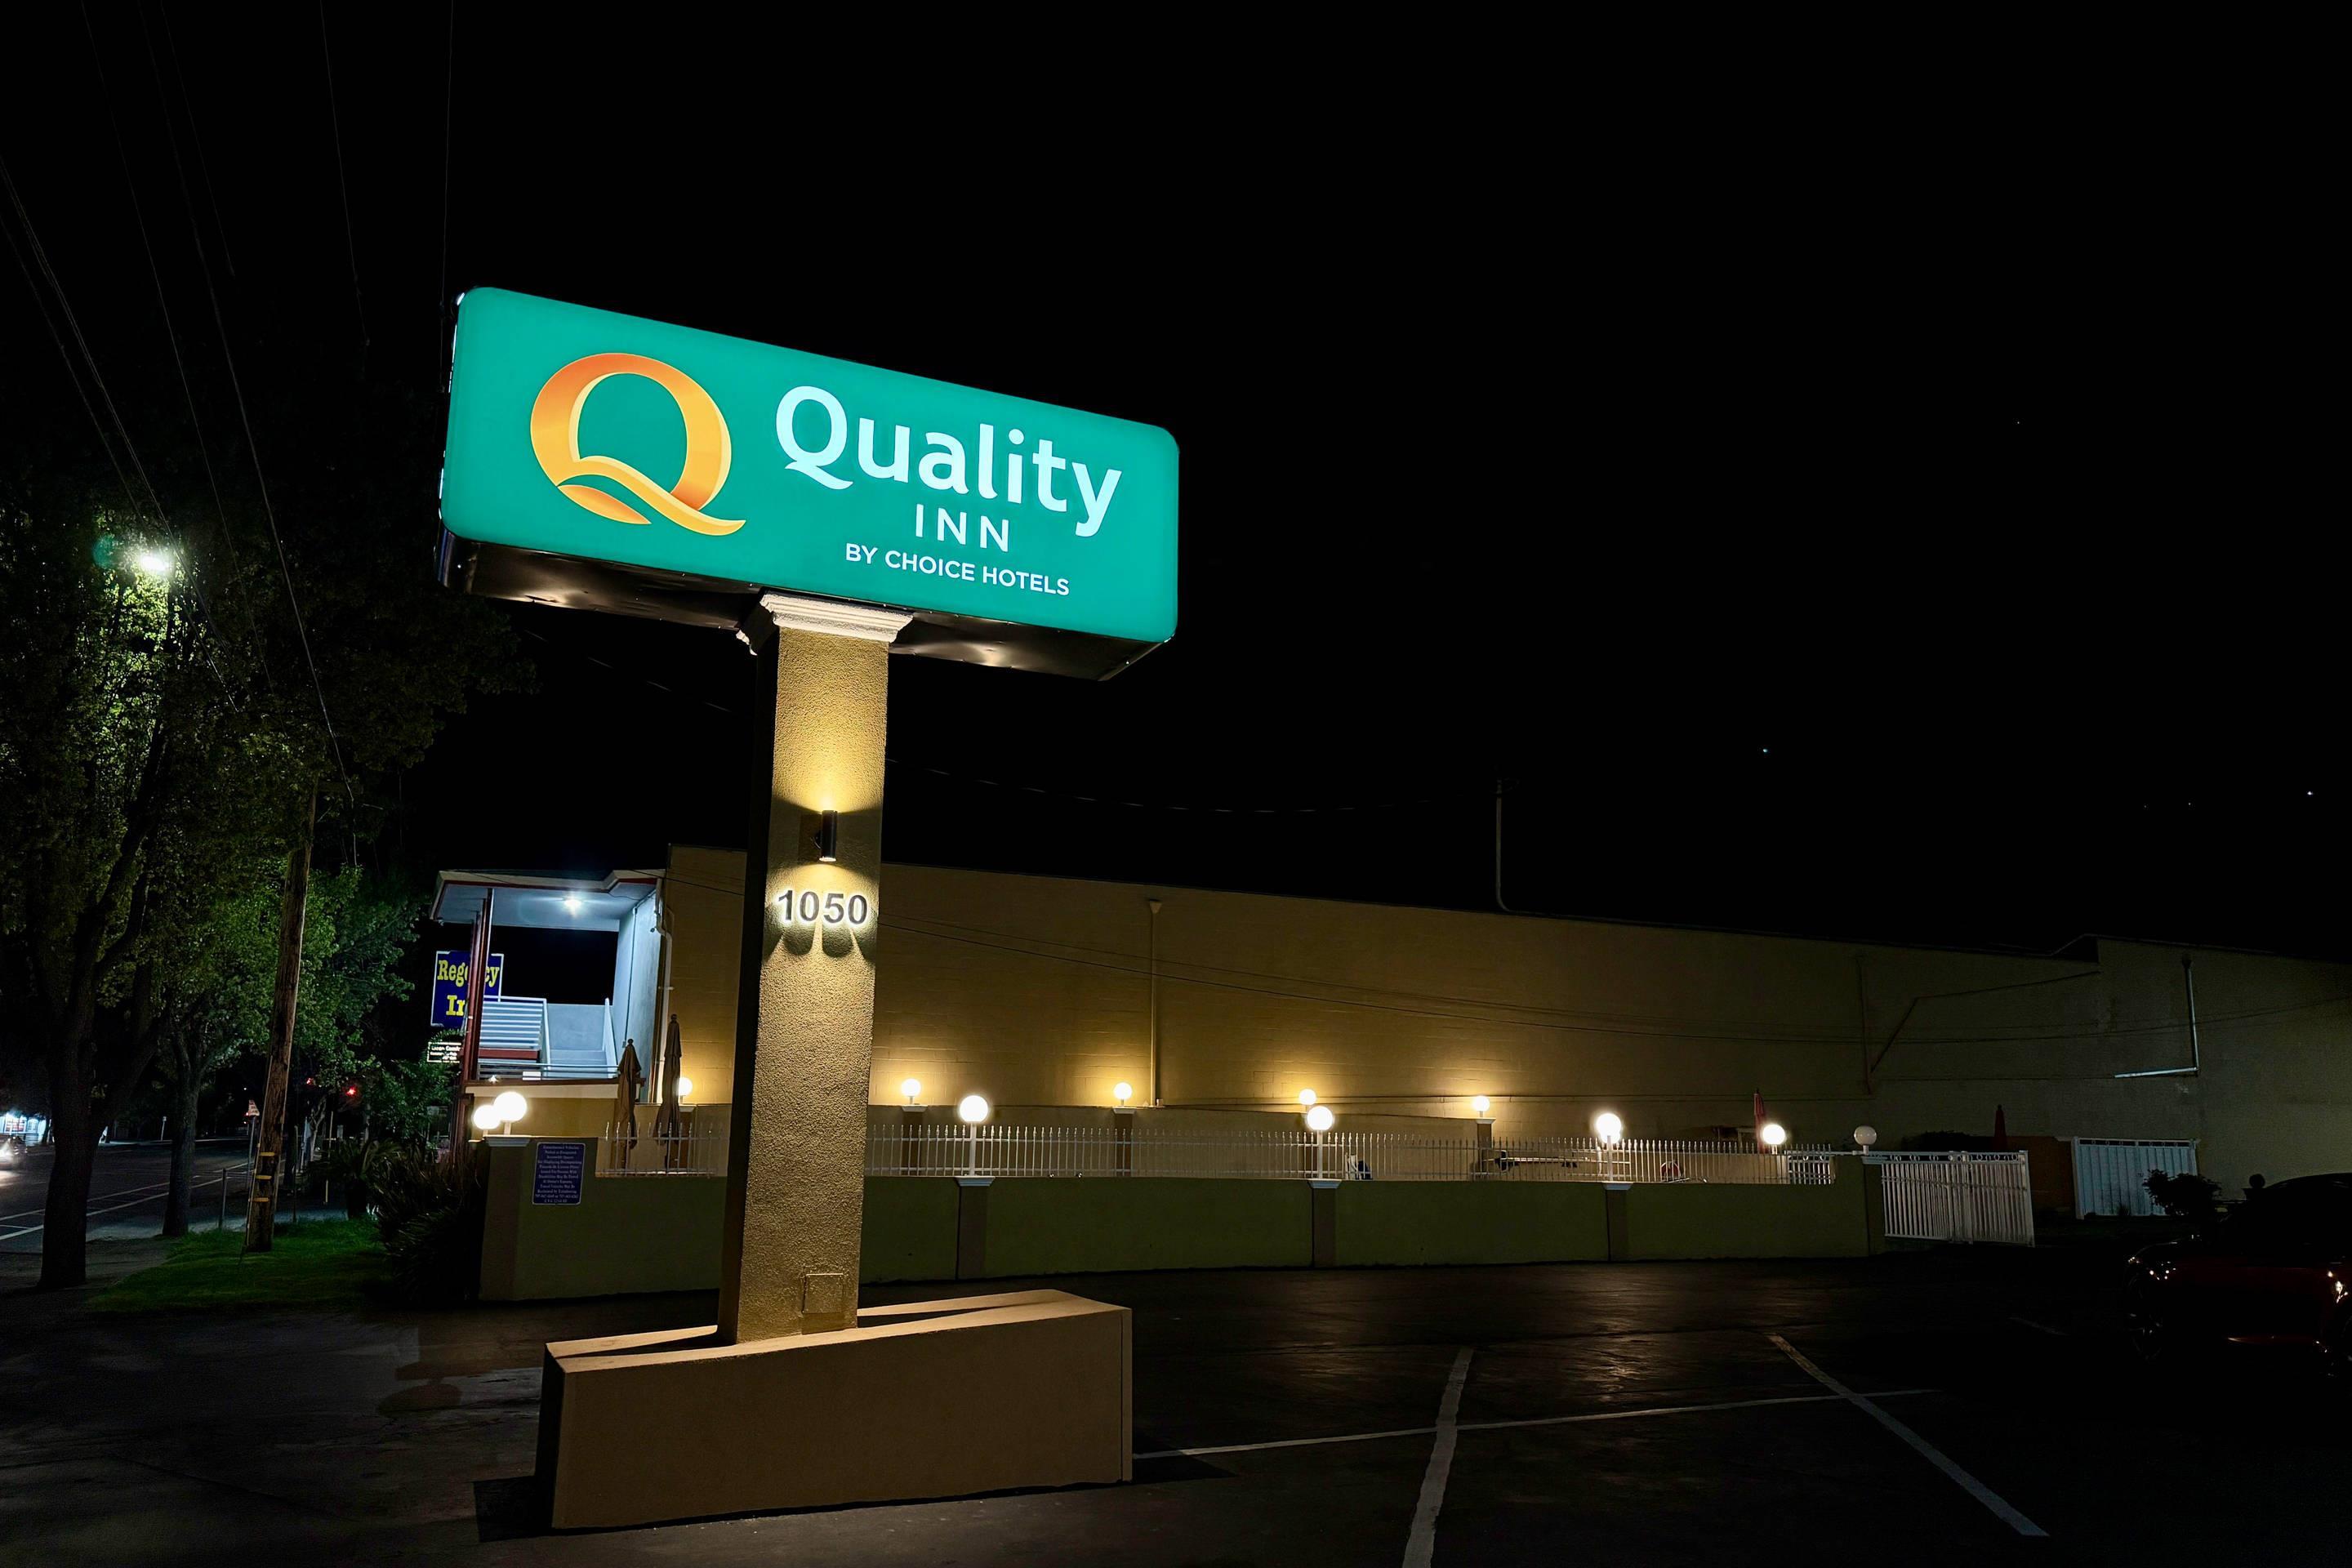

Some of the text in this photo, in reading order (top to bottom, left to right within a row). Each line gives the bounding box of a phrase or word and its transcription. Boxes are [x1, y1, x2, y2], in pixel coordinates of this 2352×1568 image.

[530, 353, 746, 536] Q
[775, 385, 1123, 537] Quality
[915, 503, 1010, 553] INN
[845, 542, 1071, 597] BY CHOICE HOTELS
[777, 889, 868, 925] 1050
[437, 960, 500, 987] Regcy
